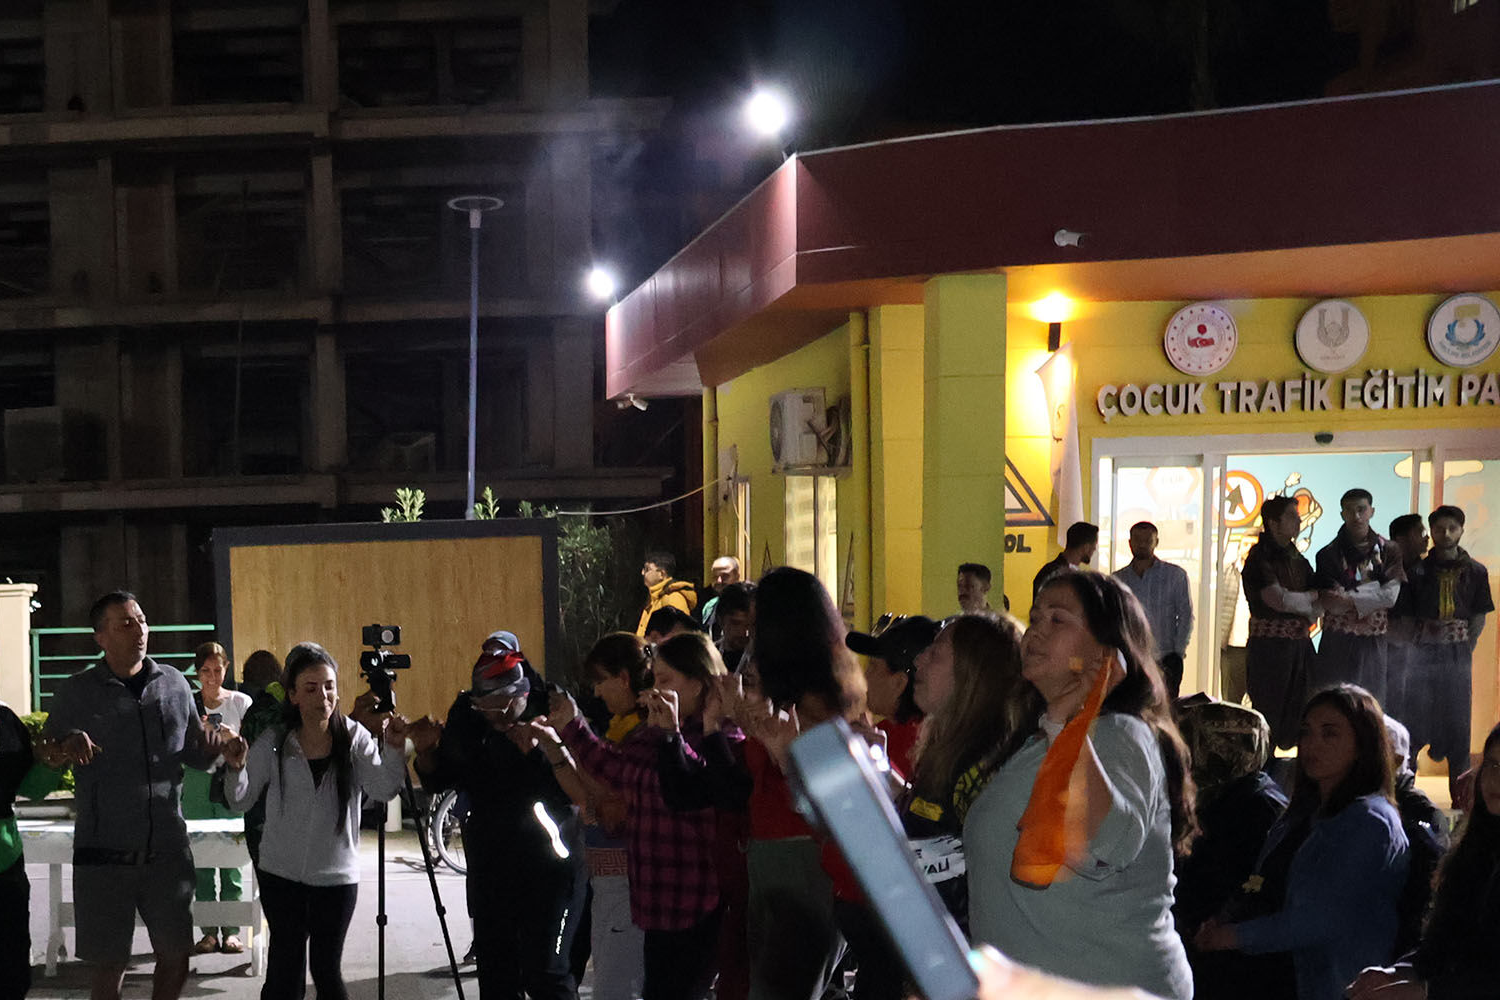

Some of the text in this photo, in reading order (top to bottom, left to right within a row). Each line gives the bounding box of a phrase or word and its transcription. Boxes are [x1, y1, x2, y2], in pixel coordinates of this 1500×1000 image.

[1097, 383, 1207, 422] ÇOCUK
[1216, 371, 1332, 414] TRAFİK
[1343, 368, 1451, 411] EĞİTİM
